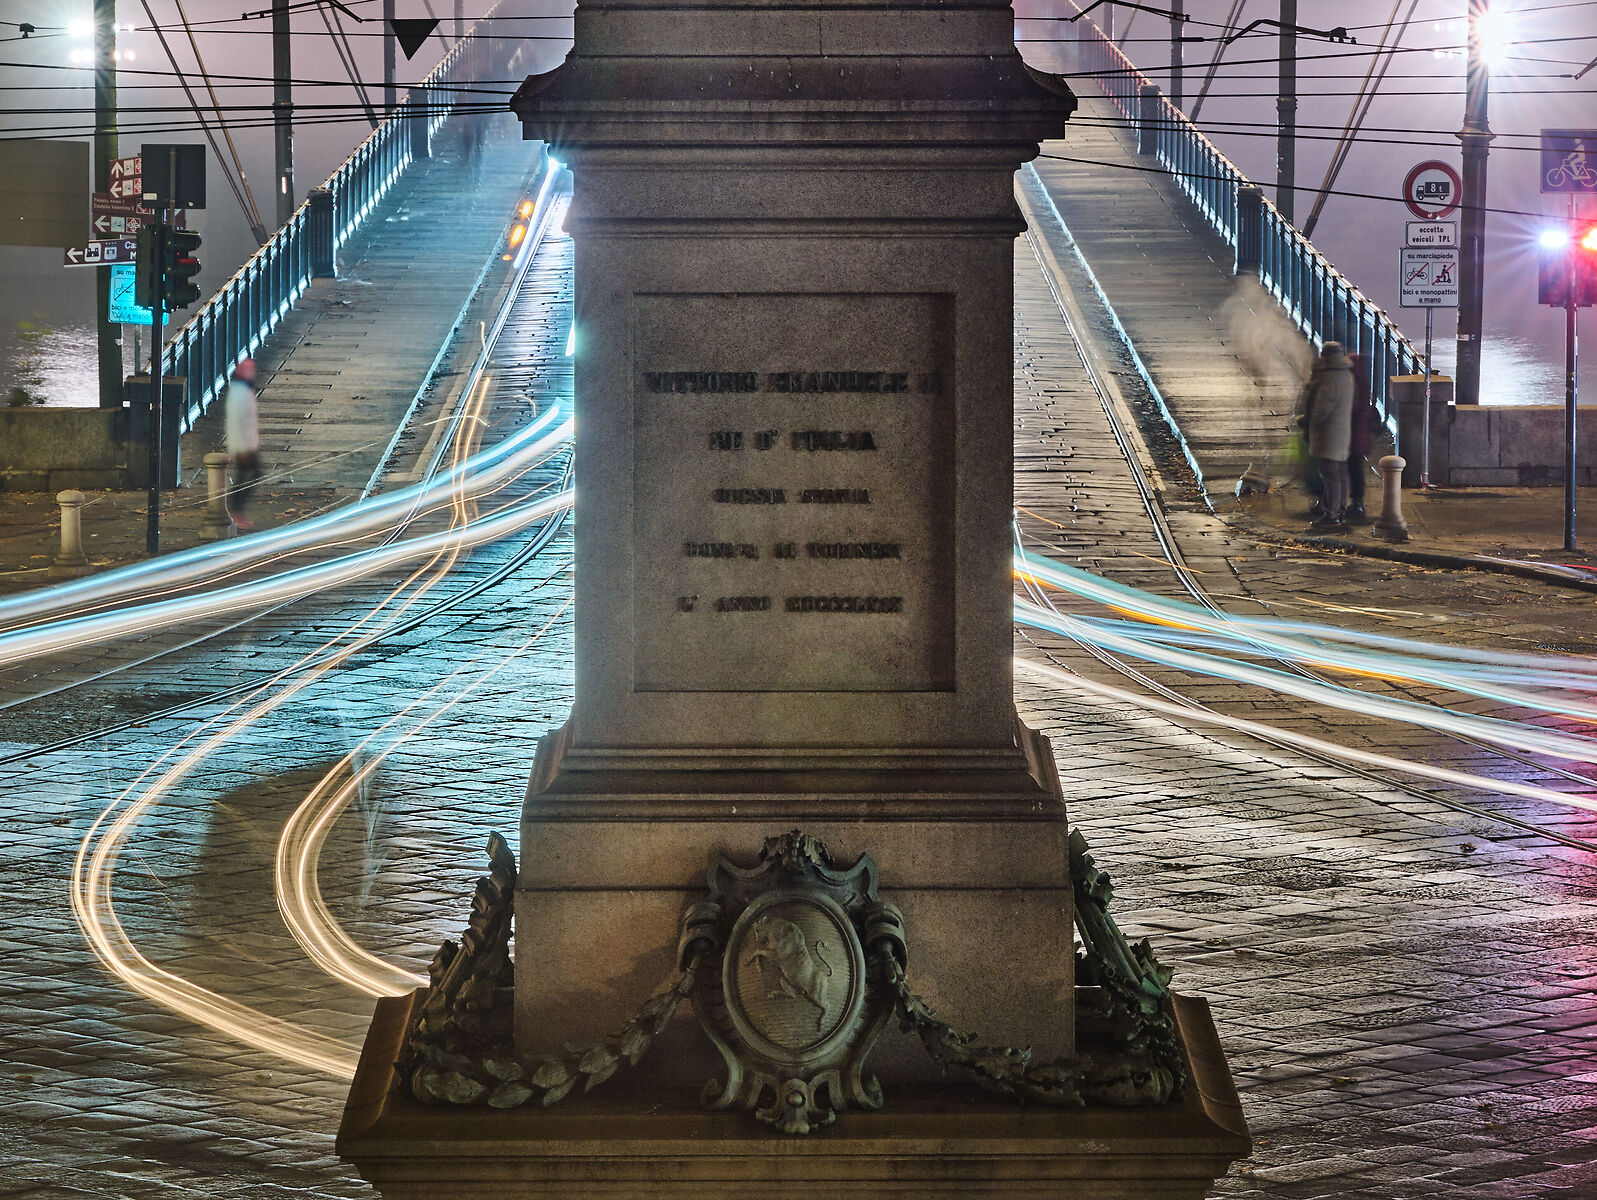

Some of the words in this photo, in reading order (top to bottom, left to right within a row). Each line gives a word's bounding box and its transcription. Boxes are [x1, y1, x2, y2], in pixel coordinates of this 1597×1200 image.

[1430, 183, 1437, 193] 8
[1419, 226, 1444, 234] eccetto
[1412, 235, 1435, 243] veicoli
[1438, 235, 1451, 243] TPL
[1403, 288, 1414, 296] bici
[1420, 289, 1457, 297] monopattini
[767, 372, 909, 393] EMANUELE
[709, 430, 744, 450] RE
